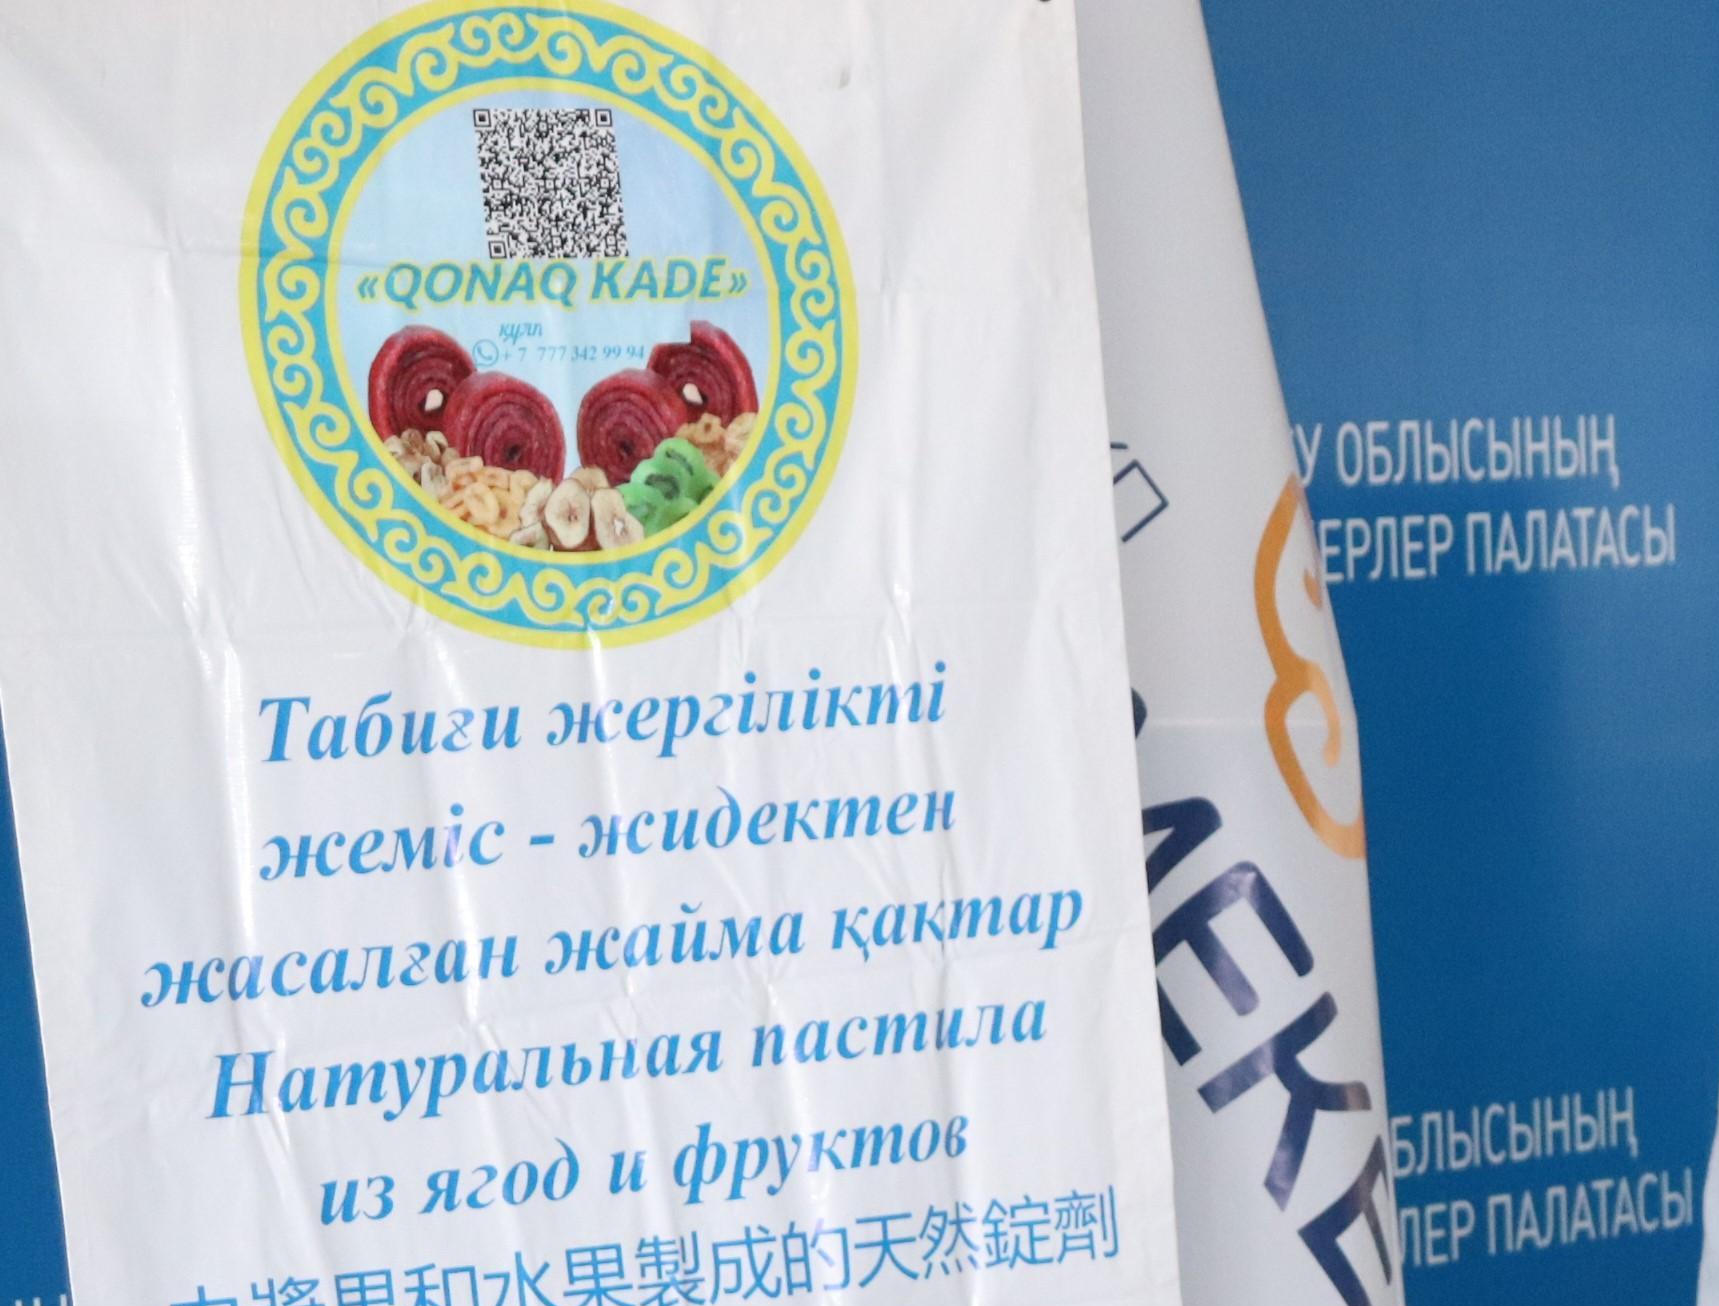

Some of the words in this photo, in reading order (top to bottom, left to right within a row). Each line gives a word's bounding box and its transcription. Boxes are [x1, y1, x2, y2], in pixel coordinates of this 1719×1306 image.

[357, 262, 576, 310] «QONAQ
[590, 257, 749, 302] KADE»
[538, 346, 567, 361] 777
[570, 345, 598, 361] 342
[602, 346, 622, 358] 99
[626, 346, 646, 358] 94
[1335, 414, 1620, 488] ОБЛЫСЫНЫҢ
[1465, 504, 1676, 576] ПАЛАТАСЫ
[259, 692, 522, 764] Табиғи
[546, 661, 947, 761] жергілікті
[259, 803, 505, 881] жеміс
[578, 787, 956, 860] жидектен
[141, 934, 519, 1008] жасалған
[544, 902, 805, 976] жайма
[831, 889, 1083, 962] қақтар
[206, 1030, 723, 1121] Натуральная
[751, 998, 1048, 1068] пастила
[320, 1168, 395, 1225] из
[420, 1139, 580, 1216] ягод
[608, 1151, 647, 1195] и
[673, 1112, 969, 1204] фруктов
[1488, 1168, 1692, 1256] ПАЛАТАСЫ
